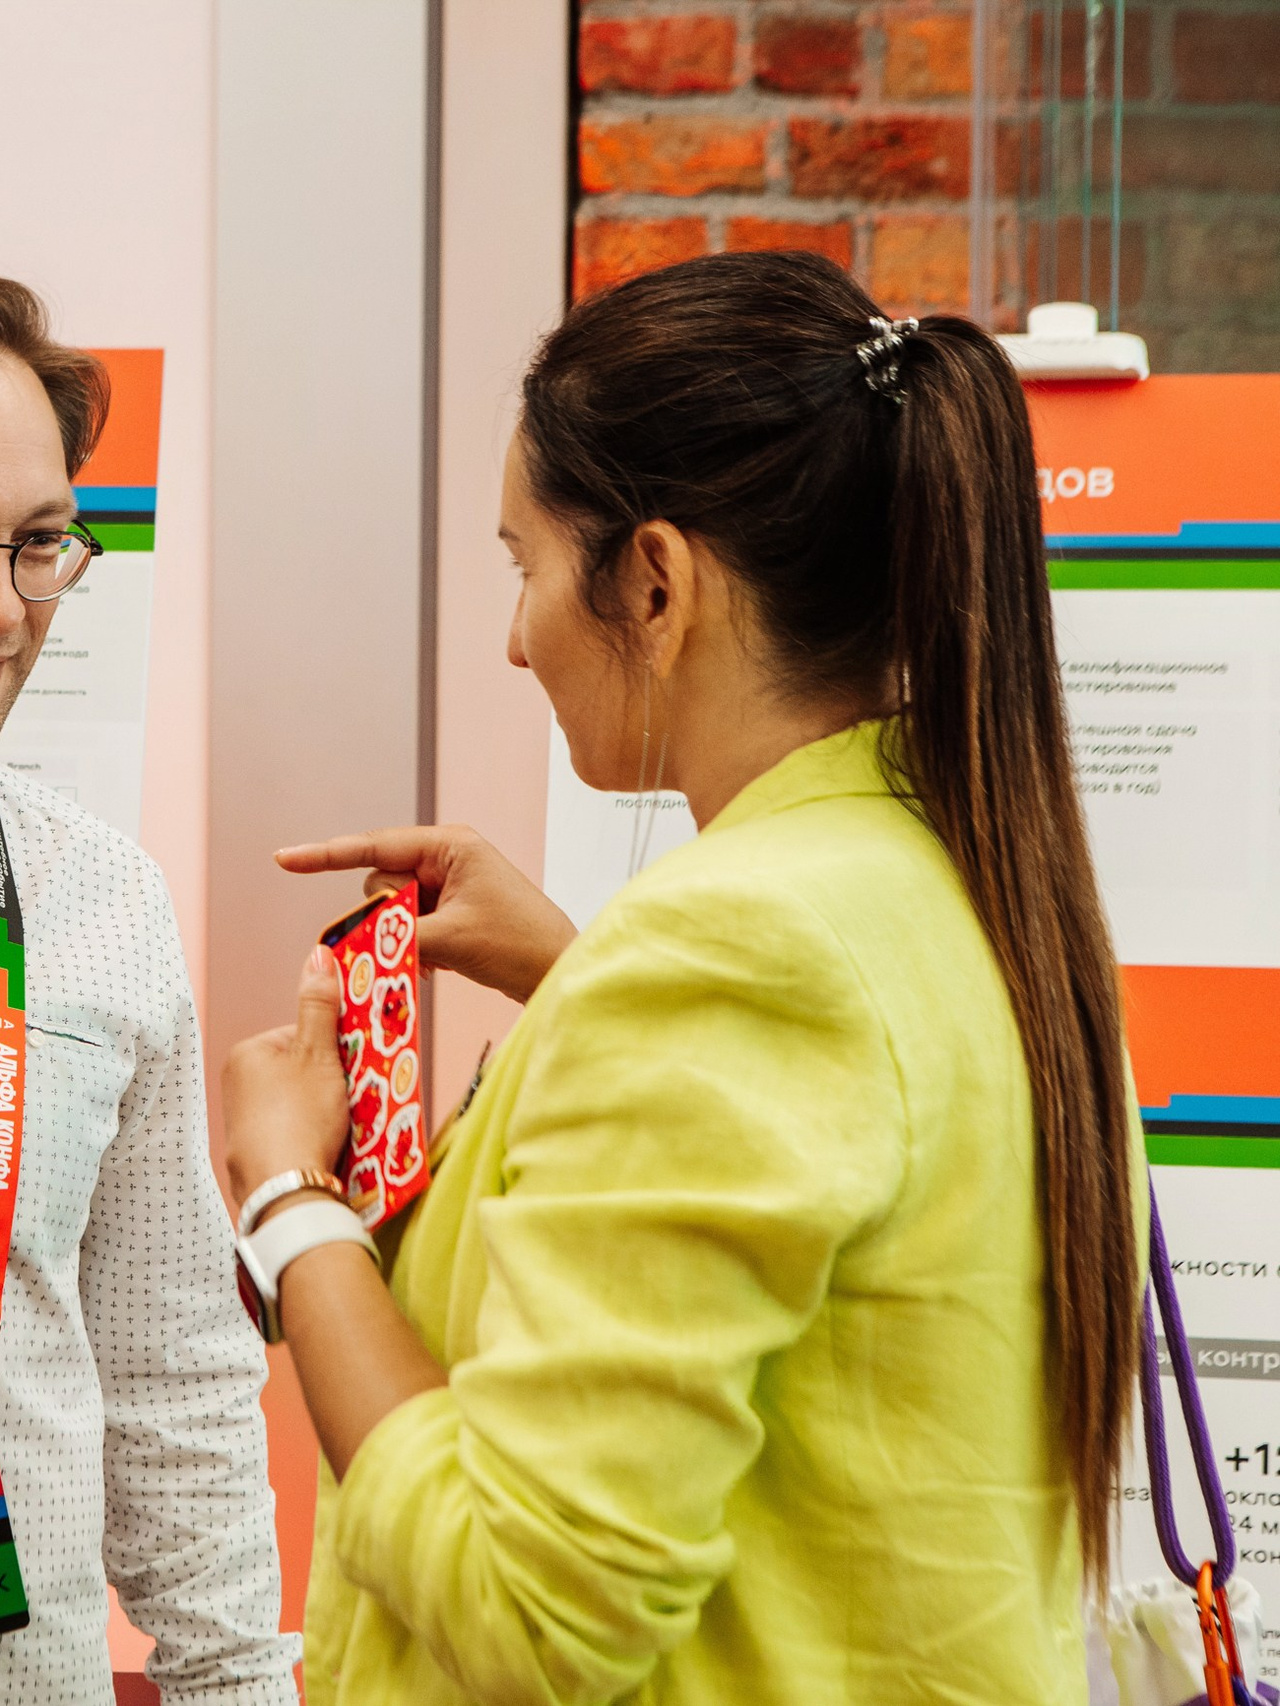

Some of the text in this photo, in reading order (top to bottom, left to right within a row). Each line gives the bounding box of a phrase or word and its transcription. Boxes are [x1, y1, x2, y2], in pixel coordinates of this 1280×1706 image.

[1036, 466, 1115, 504] ДОВ
[41, 649, 89, 659] ерехода
[615, 798, 689, 809] последни
[1197, 1350, 1280, 1375] контр
[1225, 1490, 1280, 1507] окла
[1240, 1549, 1280, 1563] кон
